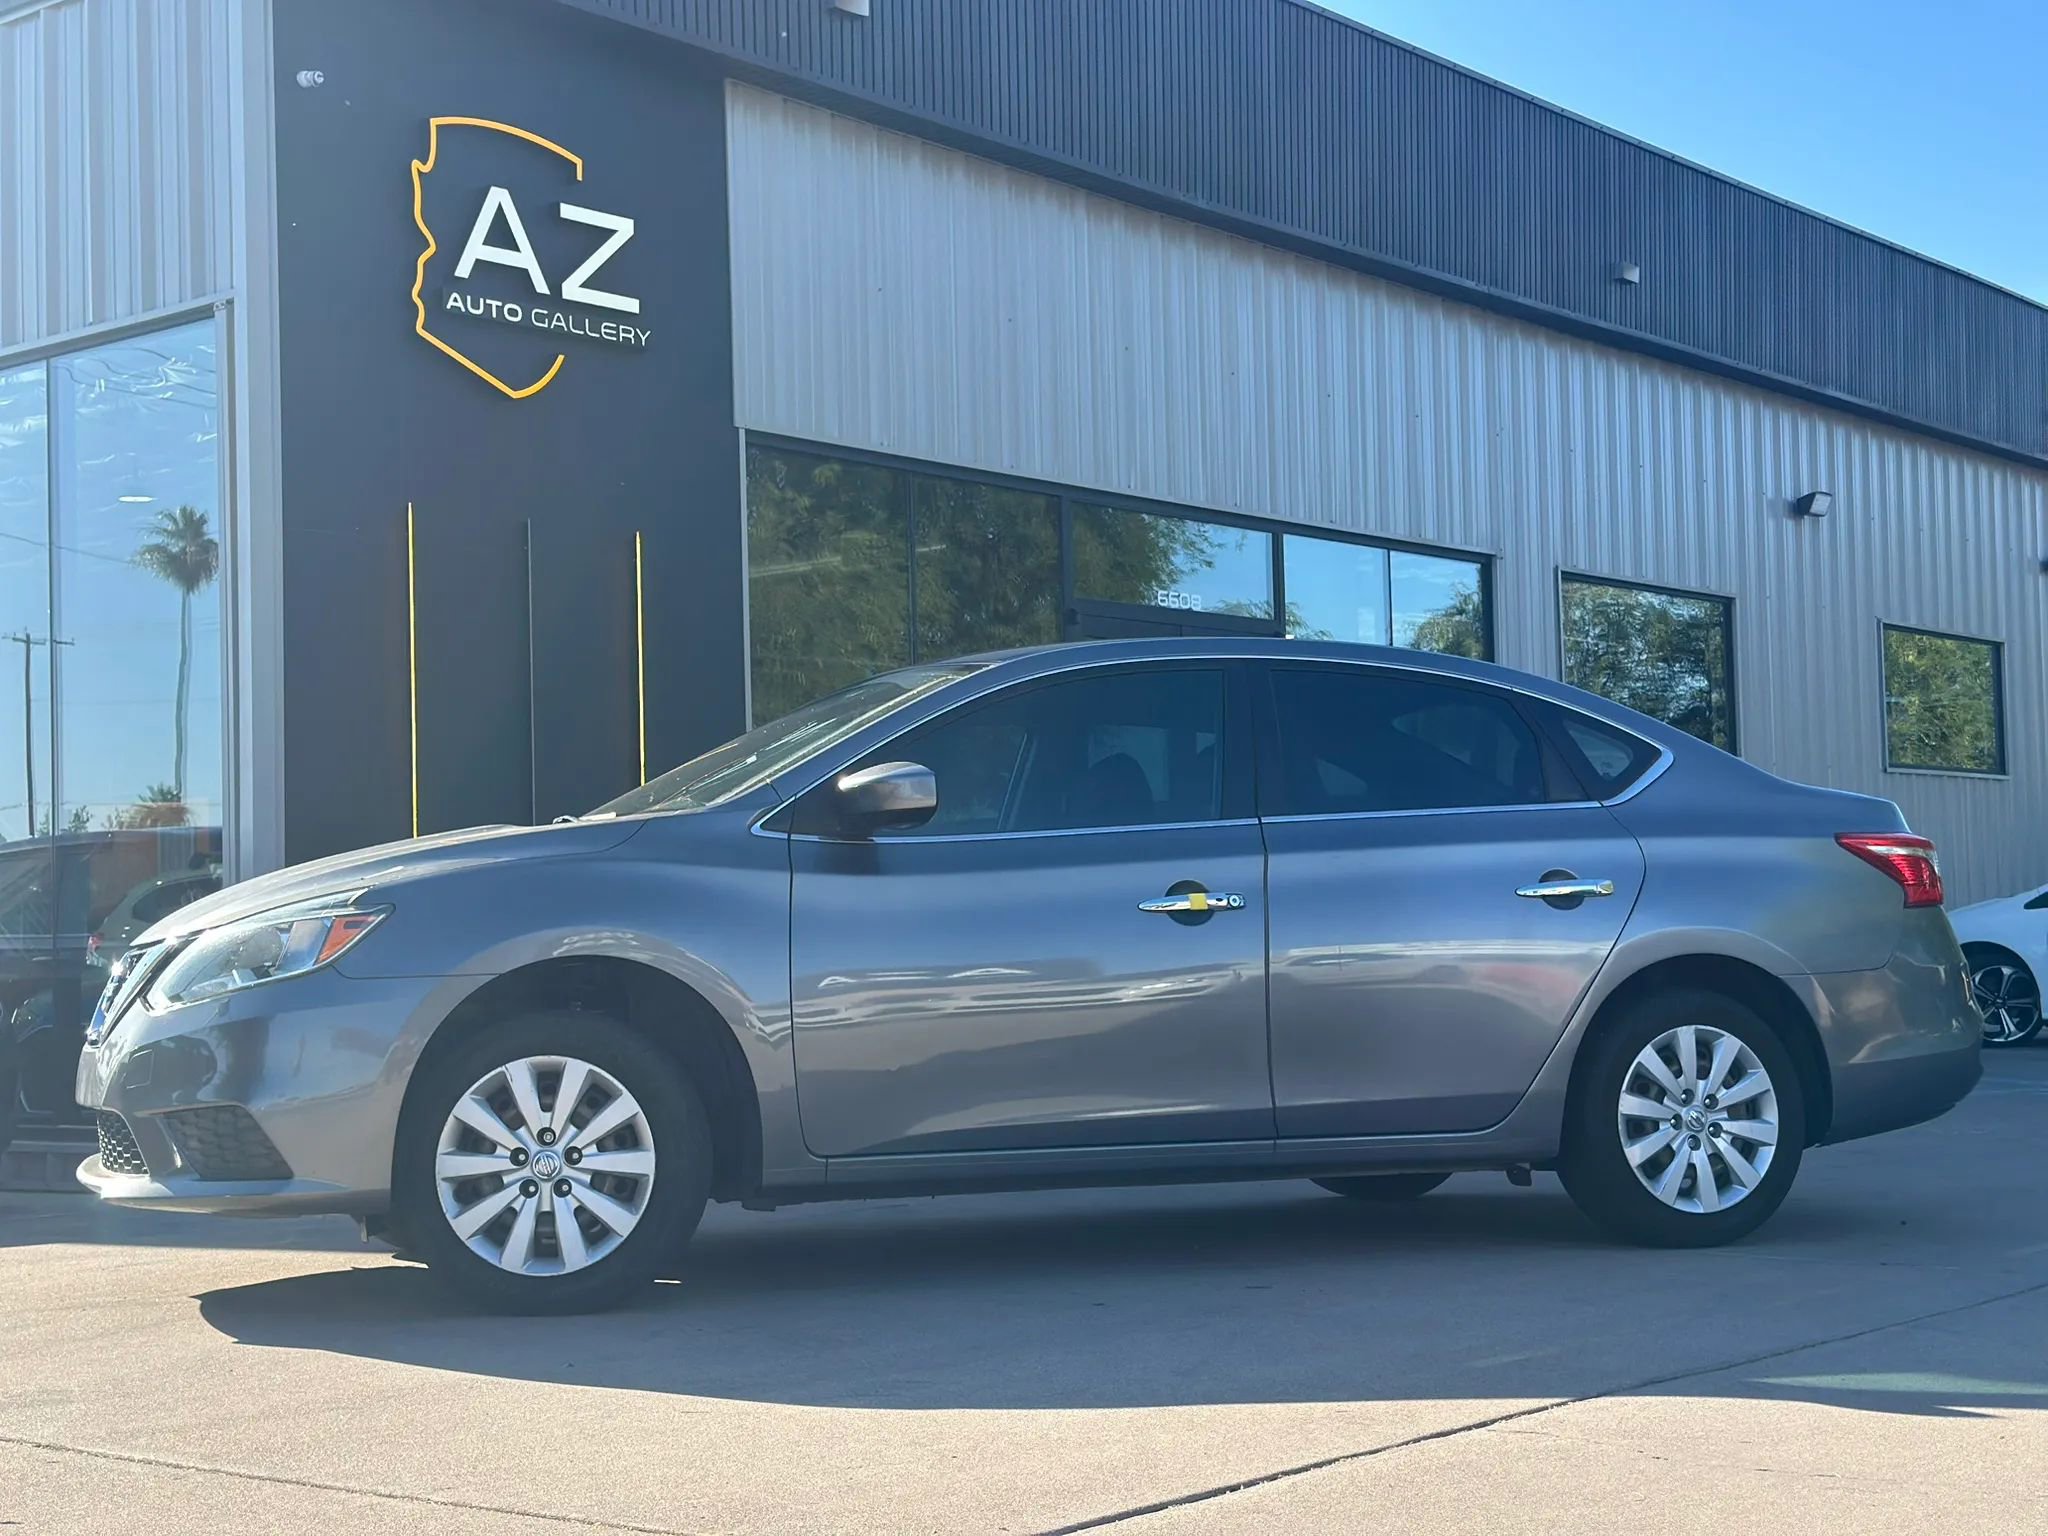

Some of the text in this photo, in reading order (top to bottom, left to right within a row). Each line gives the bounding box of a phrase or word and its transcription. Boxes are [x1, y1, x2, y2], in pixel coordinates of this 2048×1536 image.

[454, 186, 640, 314] AZ
[446, 292, 651, 346] AUTO GALLERY
[1157, 590, 1201, 611] 6608
